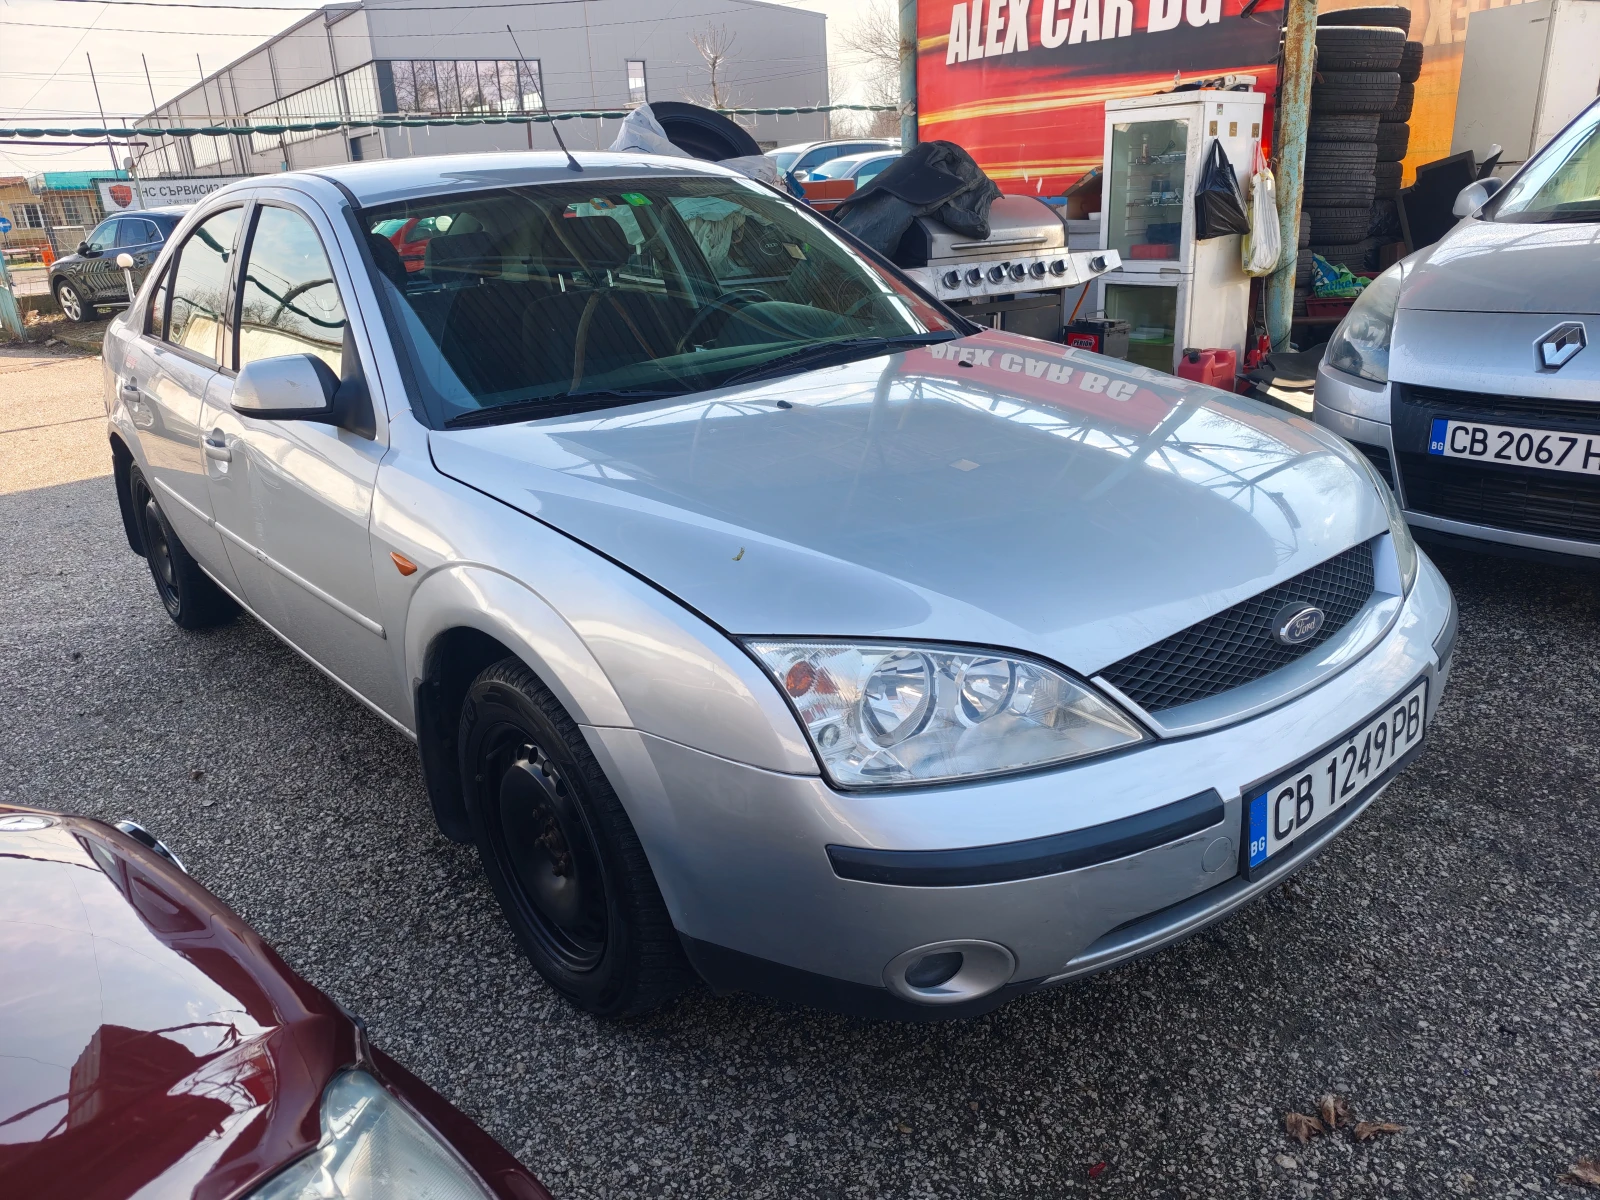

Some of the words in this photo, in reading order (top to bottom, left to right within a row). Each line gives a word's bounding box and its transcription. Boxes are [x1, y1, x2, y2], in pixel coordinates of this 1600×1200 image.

[946, 0, 1030, 65] ALEX
[1431, 441, 1444, 451] BG
[1450, 426, 1489, 456] CB
[1494, 431, 1578, 466] 2067
[1294, 615, 1316, 637] Ford
[1273, 773, 1314, 841] CB
[1326, 721, 1388, 806] 1249
[1250, 836, 1266, 857] BG
